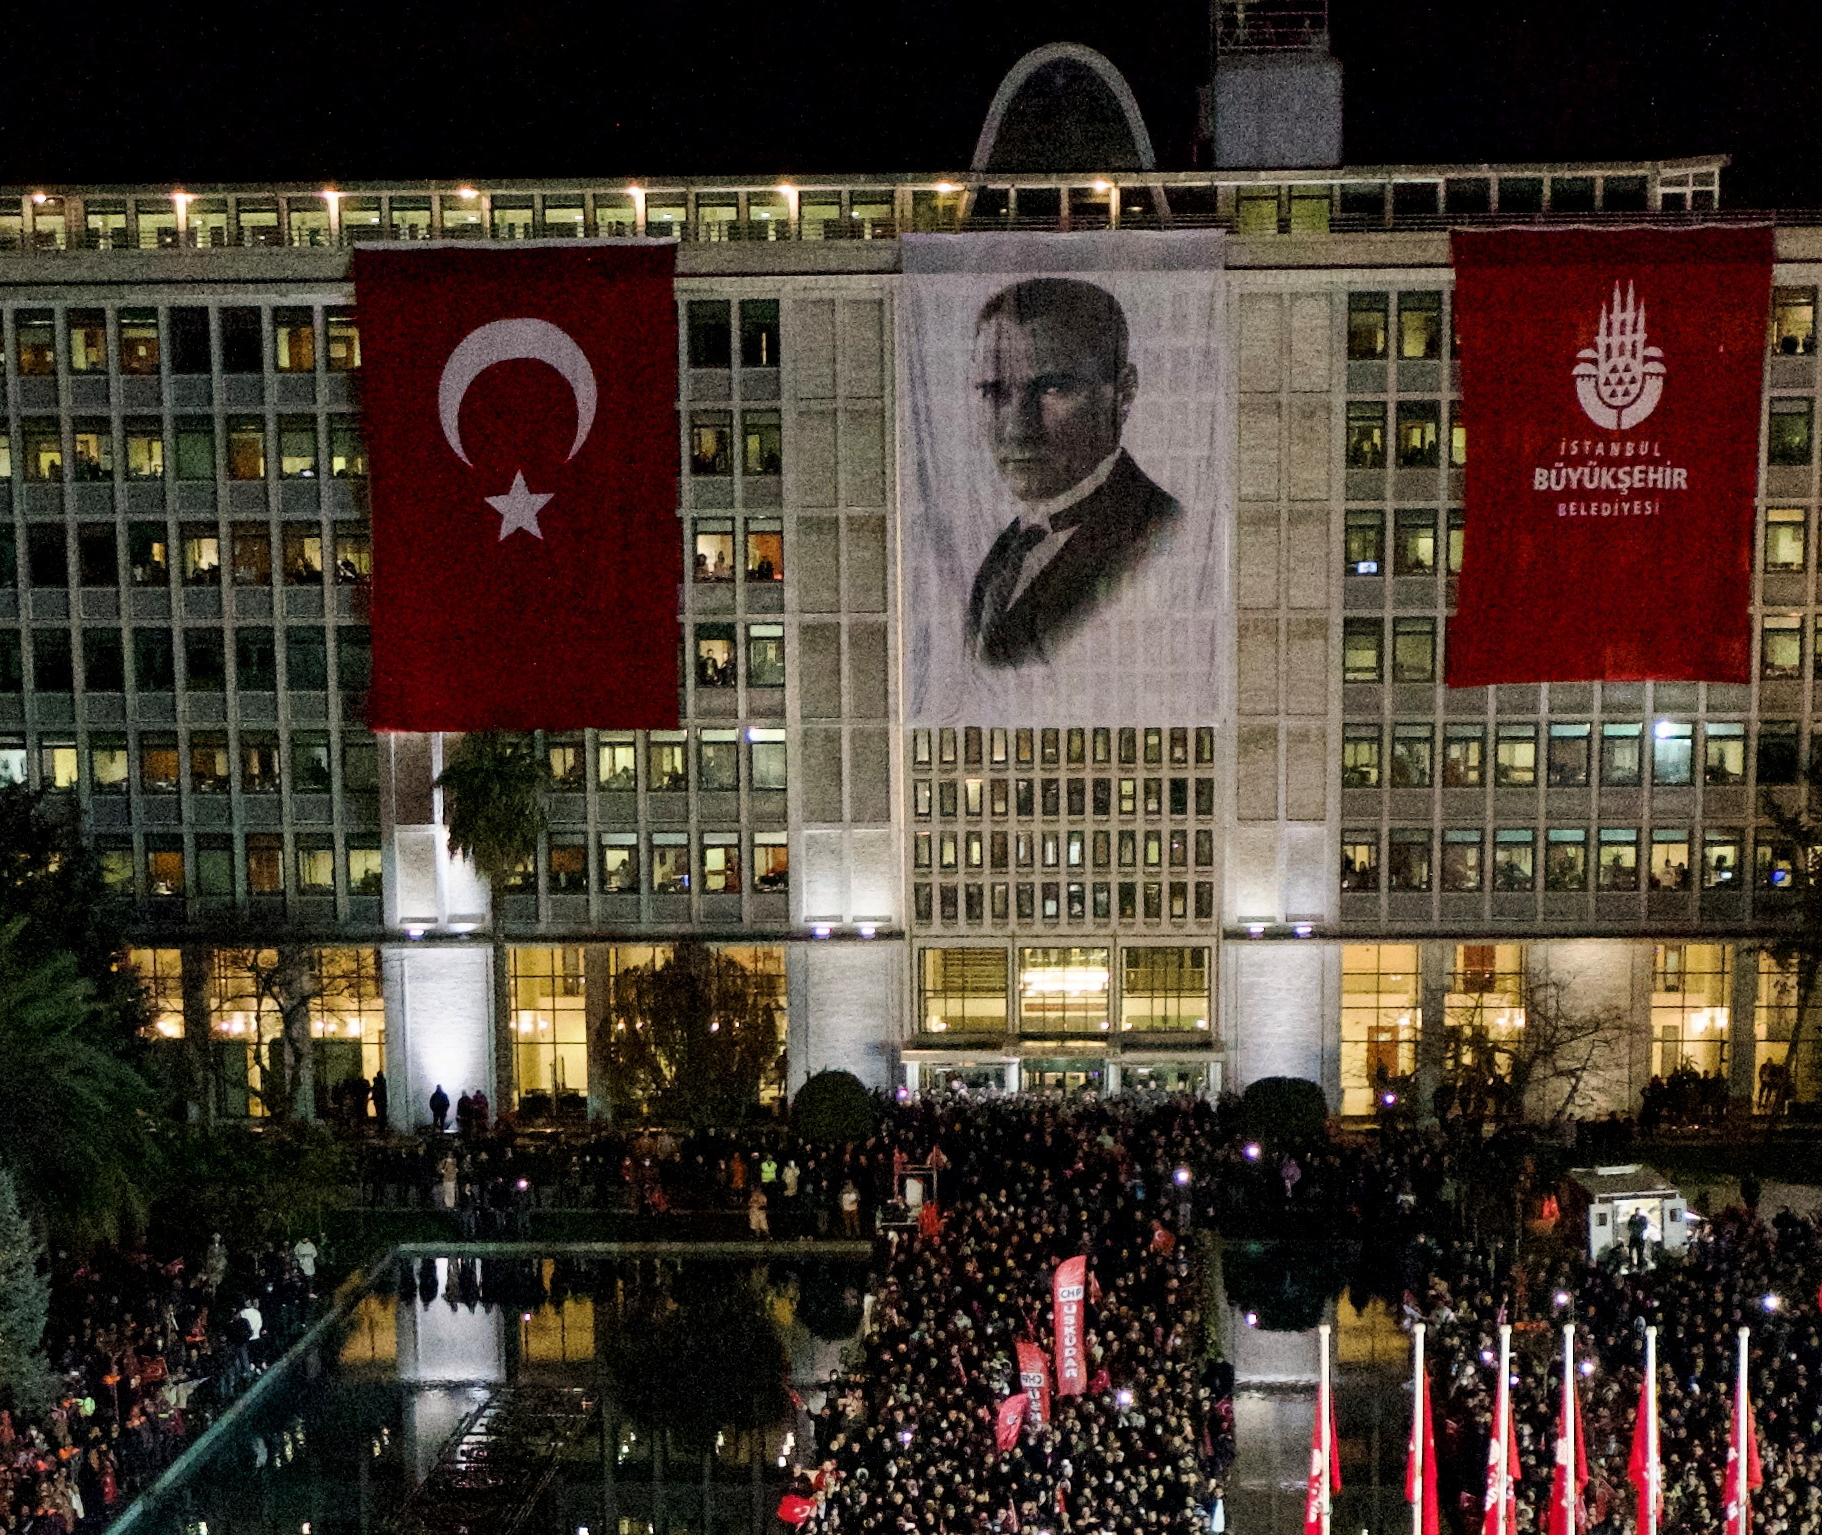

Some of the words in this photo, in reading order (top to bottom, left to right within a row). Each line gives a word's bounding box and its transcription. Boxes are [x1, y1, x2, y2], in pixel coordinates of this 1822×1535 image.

[1559, 437, 1661, 457] İSTANBUL
[1532, 460, 1688, 496] BÜYÜKŞEHİR
[1557, 499, 1660, 517] BELEDİYESİ
[1060, 1287, 1083, 1299] CHP
